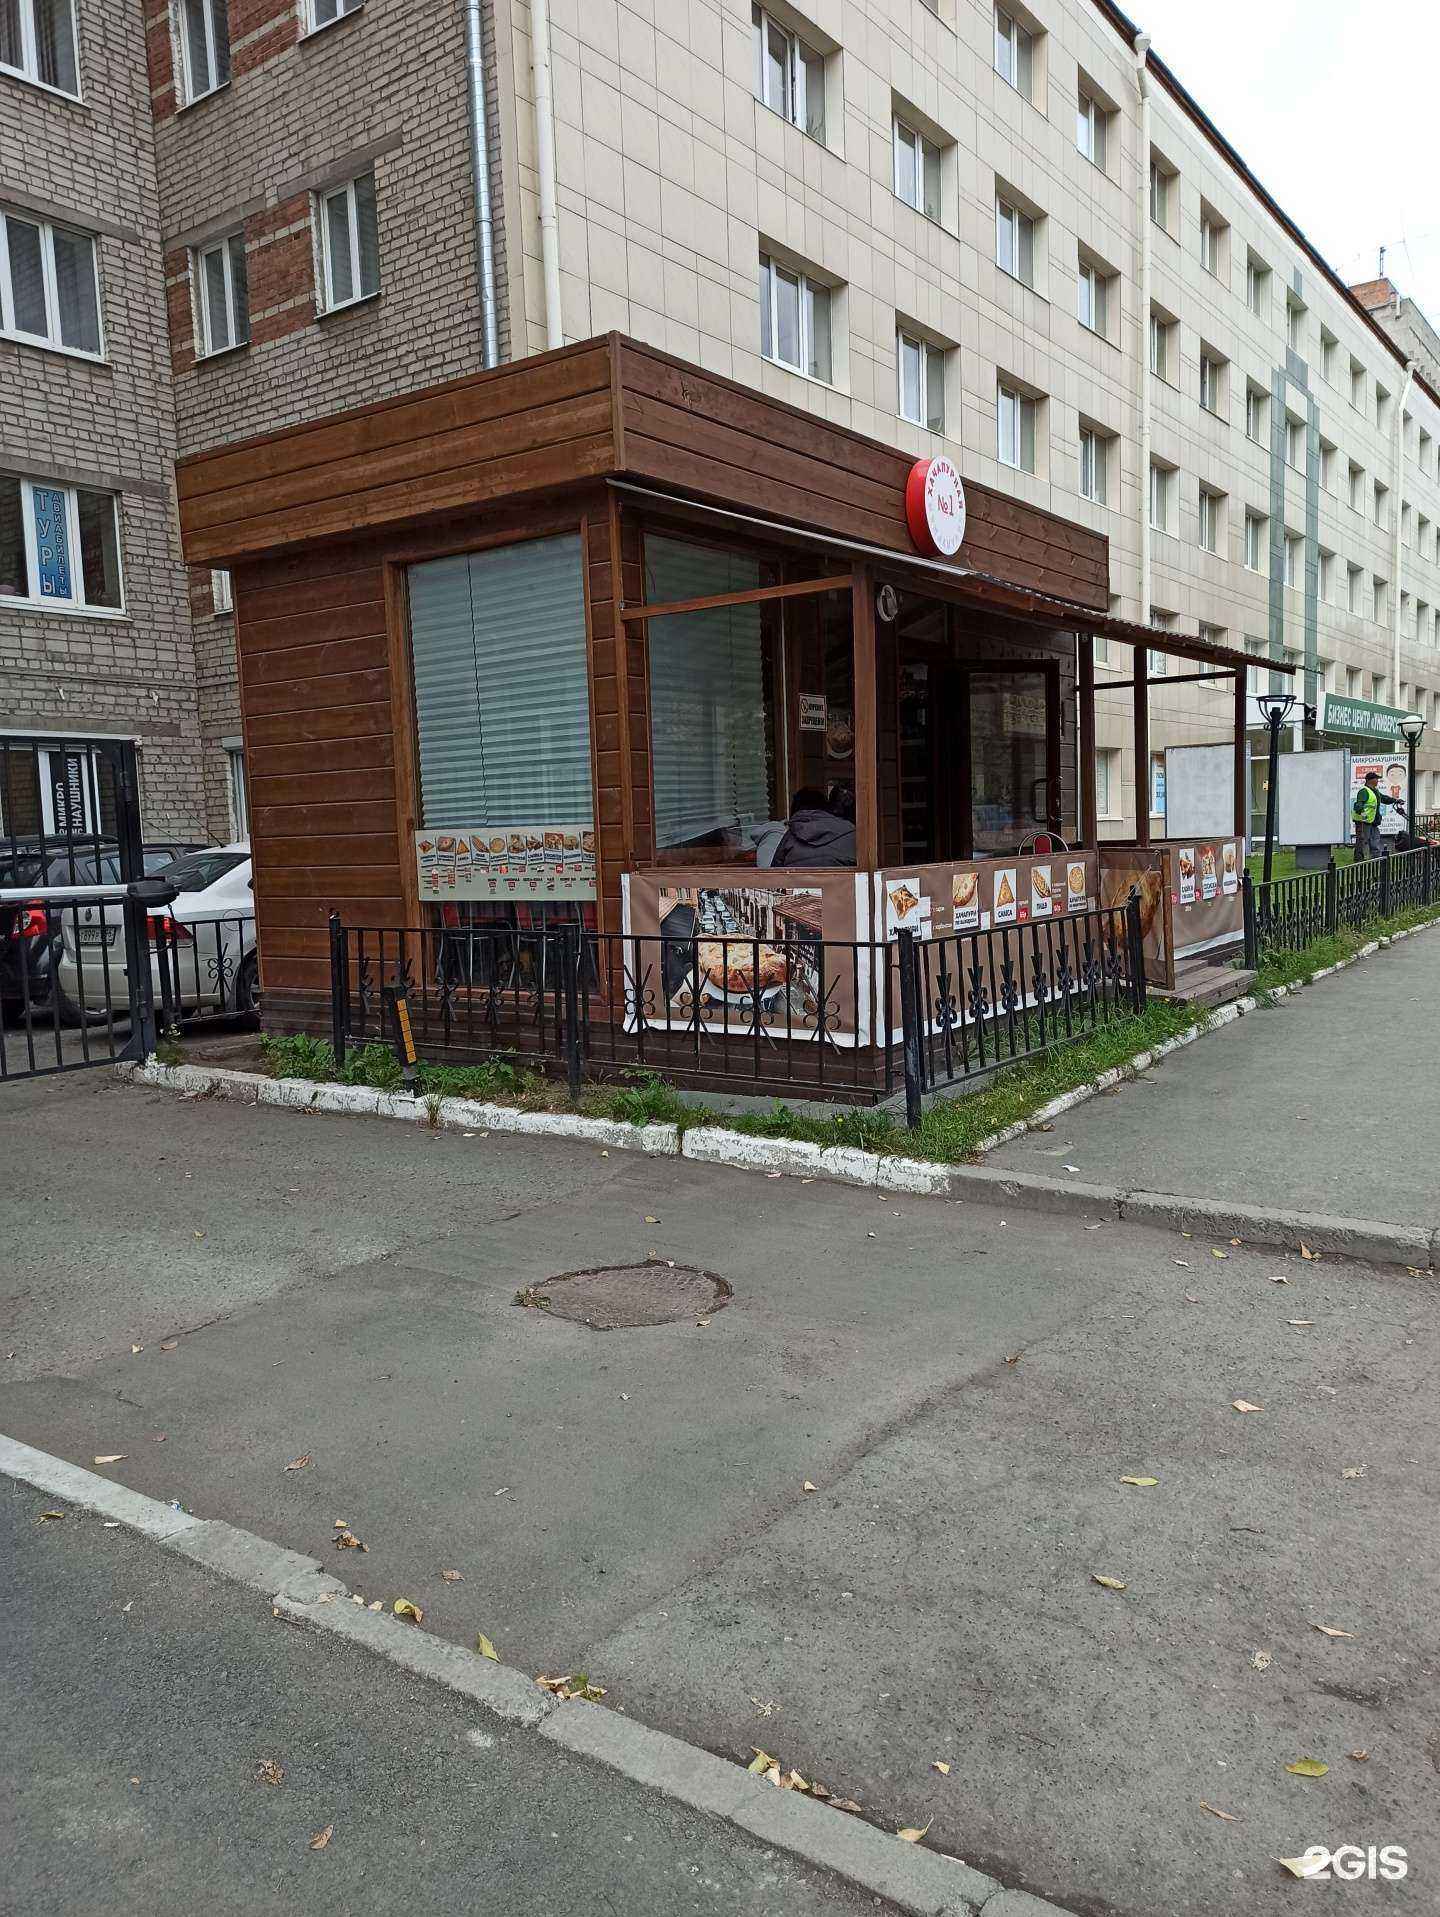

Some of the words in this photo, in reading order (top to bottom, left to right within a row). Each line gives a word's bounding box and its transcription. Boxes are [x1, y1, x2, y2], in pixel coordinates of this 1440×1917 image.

[35, 488, 56, 594] ТУРЫ
[52, 492, 68, 596] АВИАБИЛЕТЫ
[1327, 703, 1352, 728] БИЗНЕС
[1352, 708, 1371, 731] ЦЕНТР
[1352, 755, 1408, 764] МИКРОНАУШНИКИ
[67, 758, 84, 827] НАУШНИКИ
[954, 910, 978, 919] ХАЧАПУРИ
